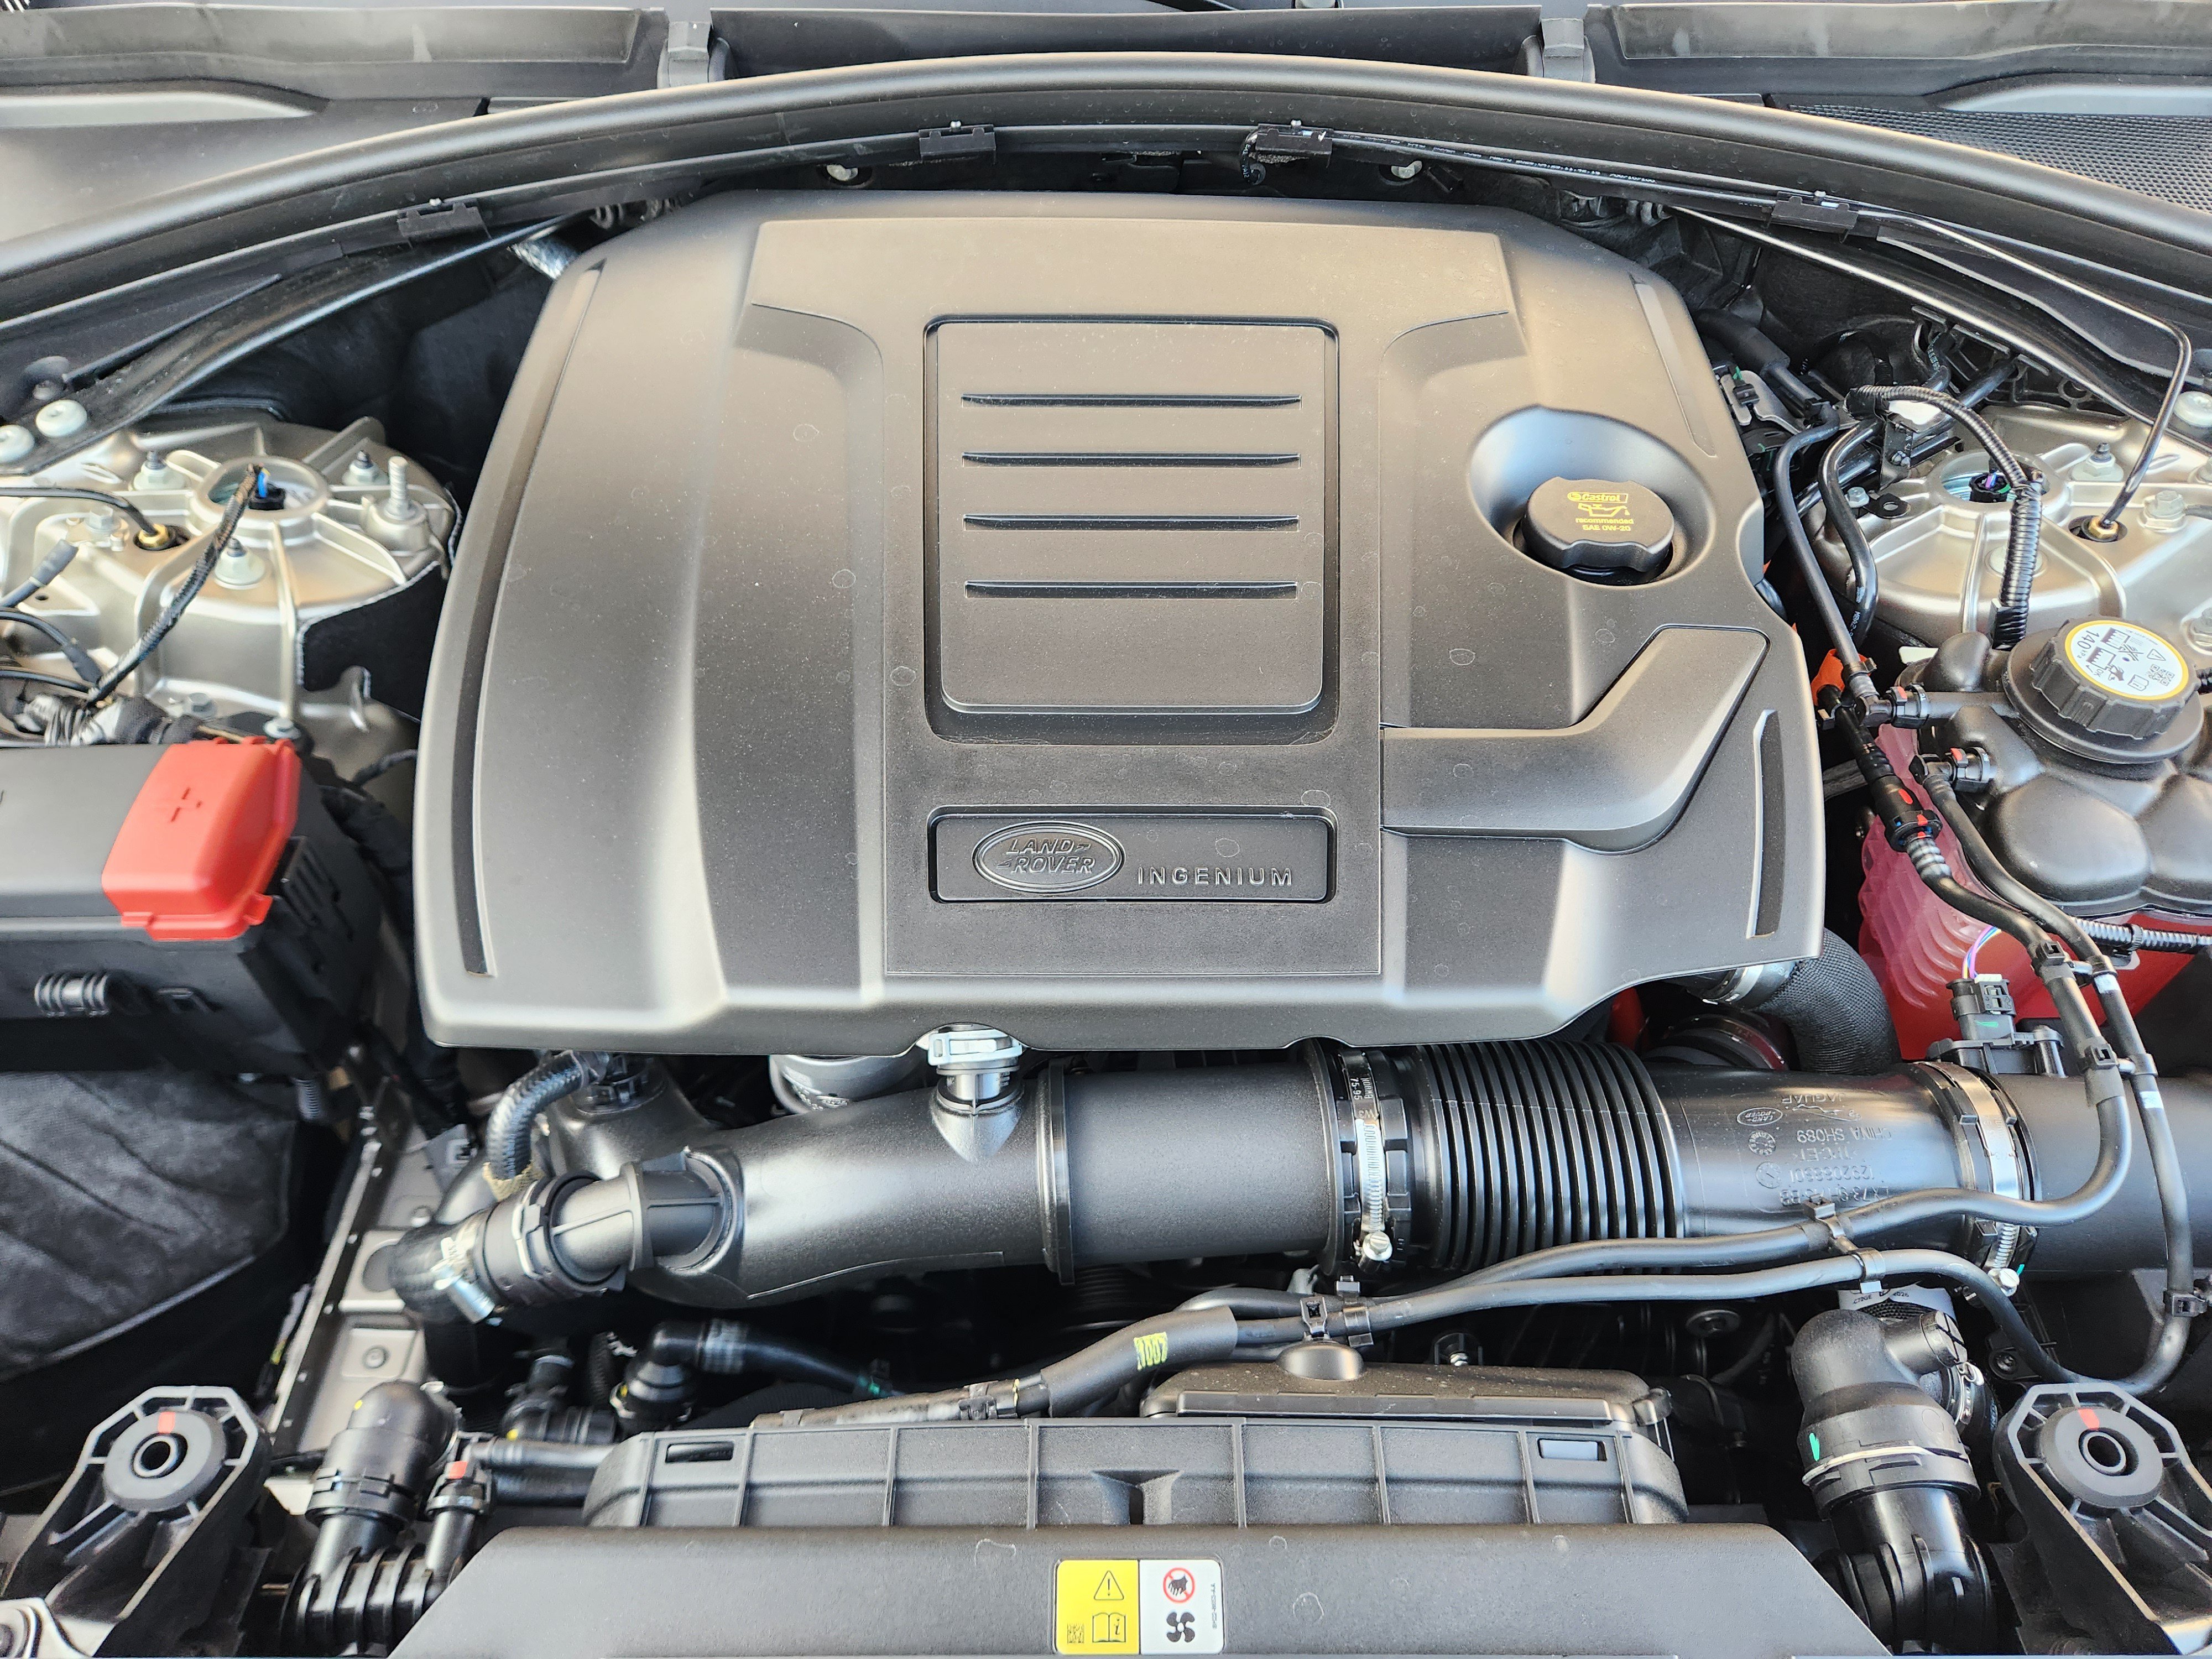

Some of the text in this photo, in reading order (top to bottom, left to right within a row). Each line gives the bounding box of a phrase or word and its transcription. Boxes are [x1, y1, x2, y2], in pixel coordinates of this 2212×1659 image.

[1582, 493, 1621, 502] Castrol
[2076, 630, 2100, 659] 140 kPa
[2091, 667, 2105, 677] OK
[1006, 838, 1075, 855] LAND
[1010, 855, 1096, 874] ROVER
[1137, 866, 1293, 886] INGENIUM
[1350, 1077, 1363, 1100] 75-95
[1781, 1093, 1846, 1104] JAGUAR
[1796, 1126, 1892, 1143] CHINA SH089
